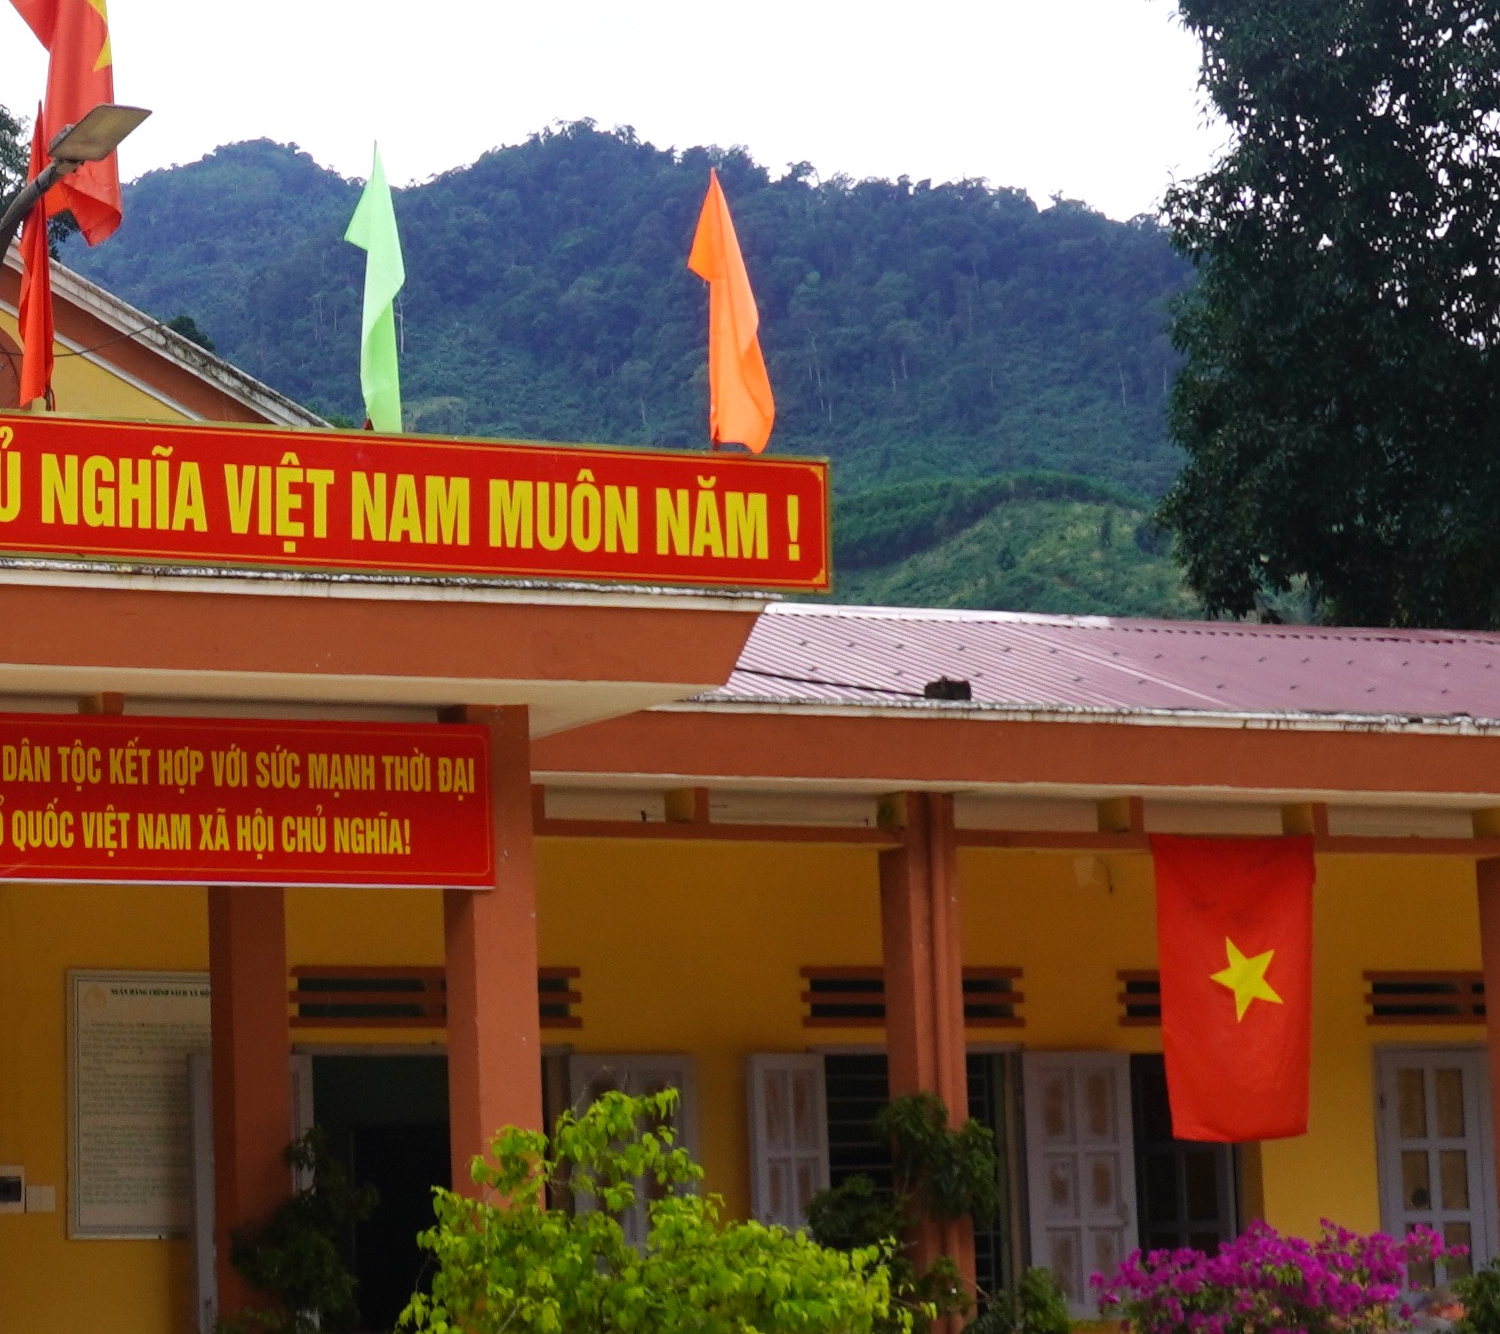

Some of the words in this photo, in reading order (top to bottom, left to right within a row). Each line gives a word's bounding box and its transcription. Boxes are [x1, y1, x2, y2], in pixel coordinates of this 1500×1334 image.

[42, 446, 207, 531] NGHĨA
[224, 452, 334, 552] VIỆT
[352, 472, 469, 545] NAM
[489, 465, 638, 553] MUÔN
[656, 475, 769, 559] NĂM
[787, 495, 800, 560] !
[2, 737, 50, 782] DÂN
[58, 739, 101, 791] TỘC
[109, 737, 151, 784] KẾT
[158, 746, 204, 793] HỢP
[211, 744, 247, 787] VỚI
[256, 745, 300, 789] SỨC
[308, 753, 375, 798] MẠNH
[382, 747, 431, 792] THỜI
[438, 757, 475, 801] ĐẠI
[12, 798, 74, 851] QUỐC
[82, 805, 130, 857] VIỆT
[138, 813, 192, 851] NAM
[199, 807, 230, 851] XÃ
[237, 808, 274, 860] HỘI
[282, 805, 327, 853] CHỦ
[334, 811, 411, 855] NGHĨA!
